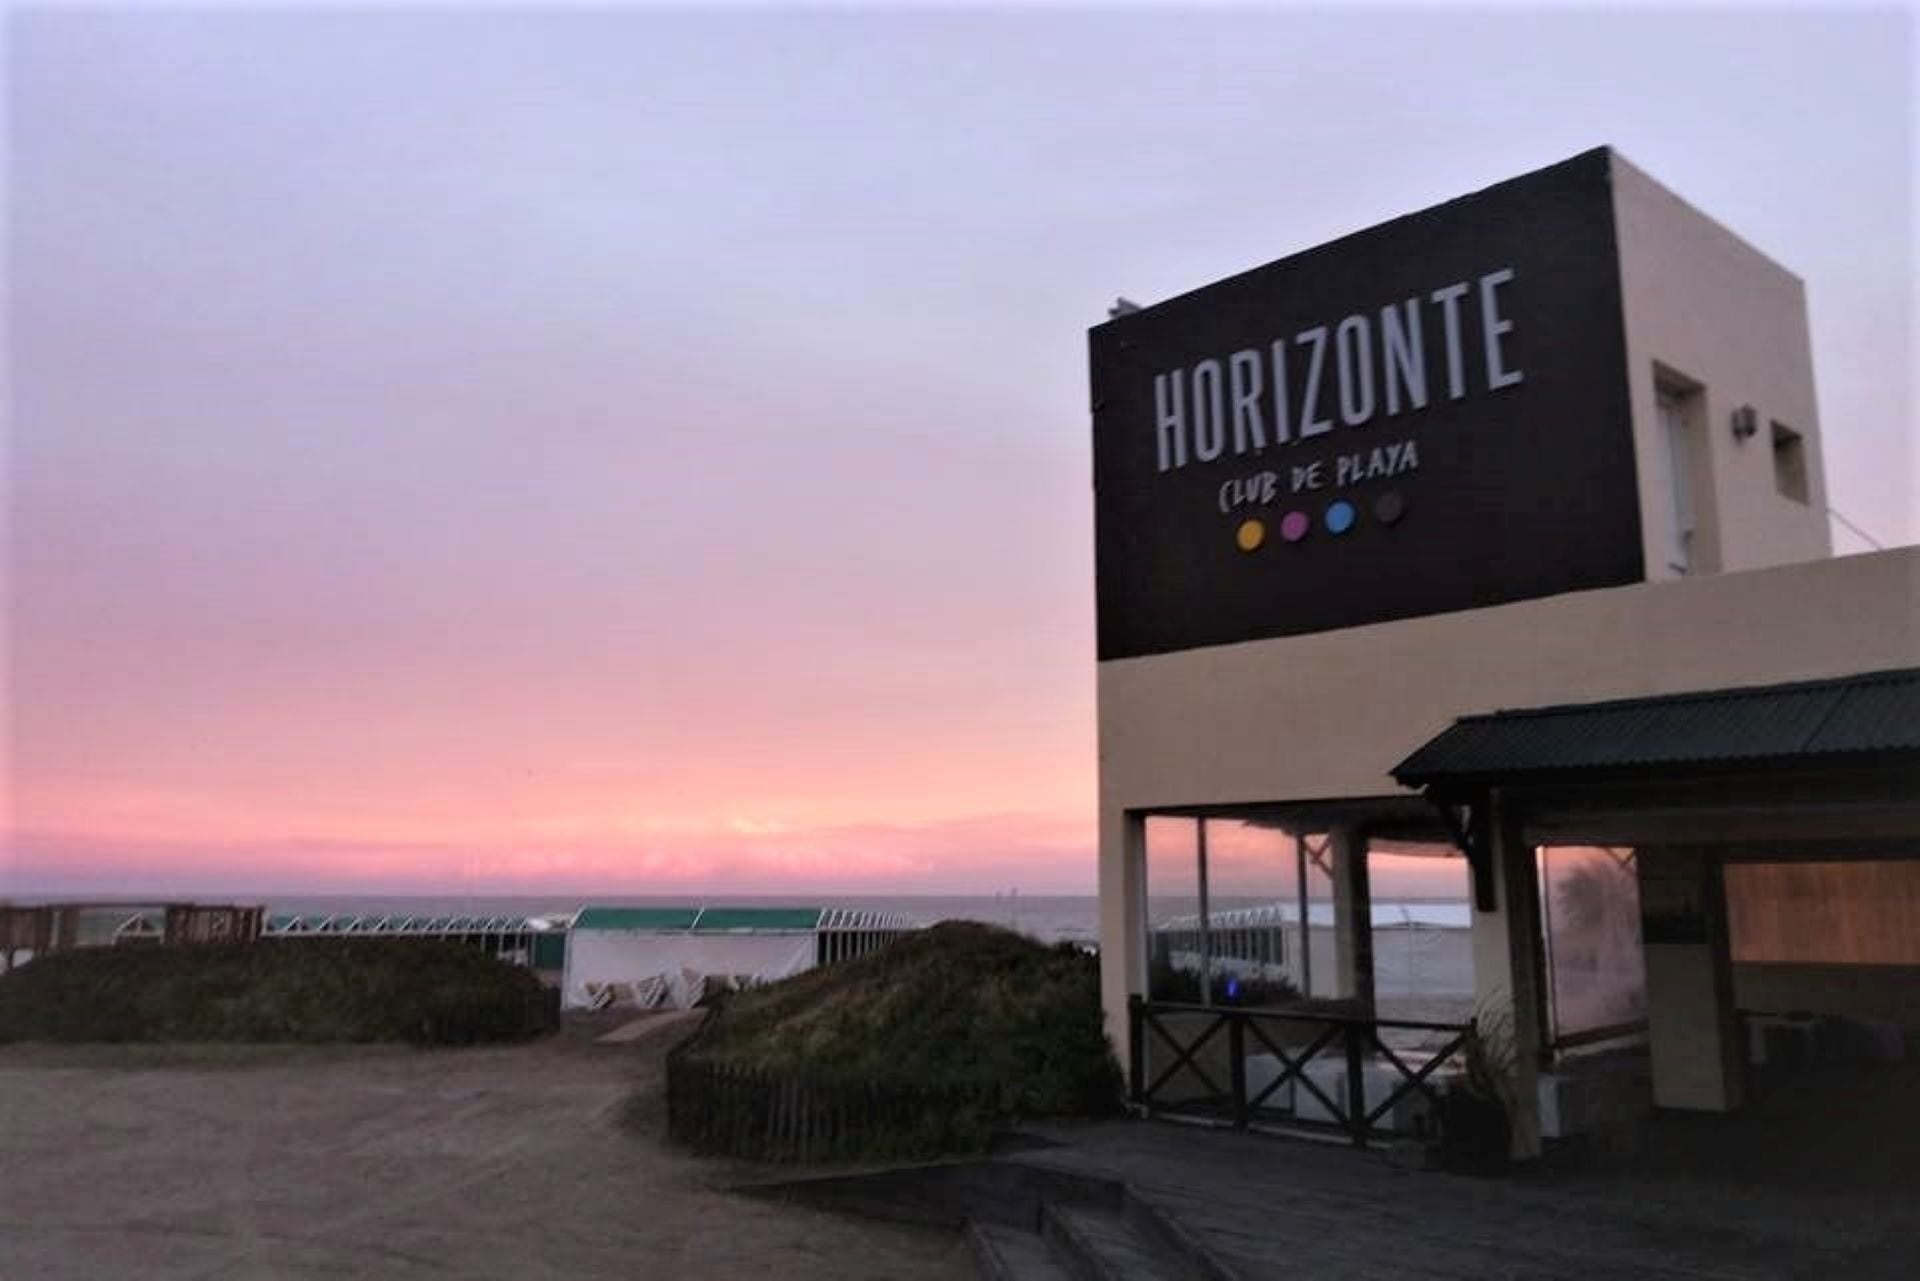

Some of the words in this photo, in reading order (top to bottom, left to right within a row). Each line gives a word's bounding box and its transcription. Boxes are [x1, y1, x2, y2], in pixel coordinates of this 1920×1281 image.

[1154, 268, 1524, 472] HORIZONTE
[1219, 471, 1278, 512] CLUB
[1291, 460, 1323, 492] DE
[1336, 440, 1419, 487] PLAYA
